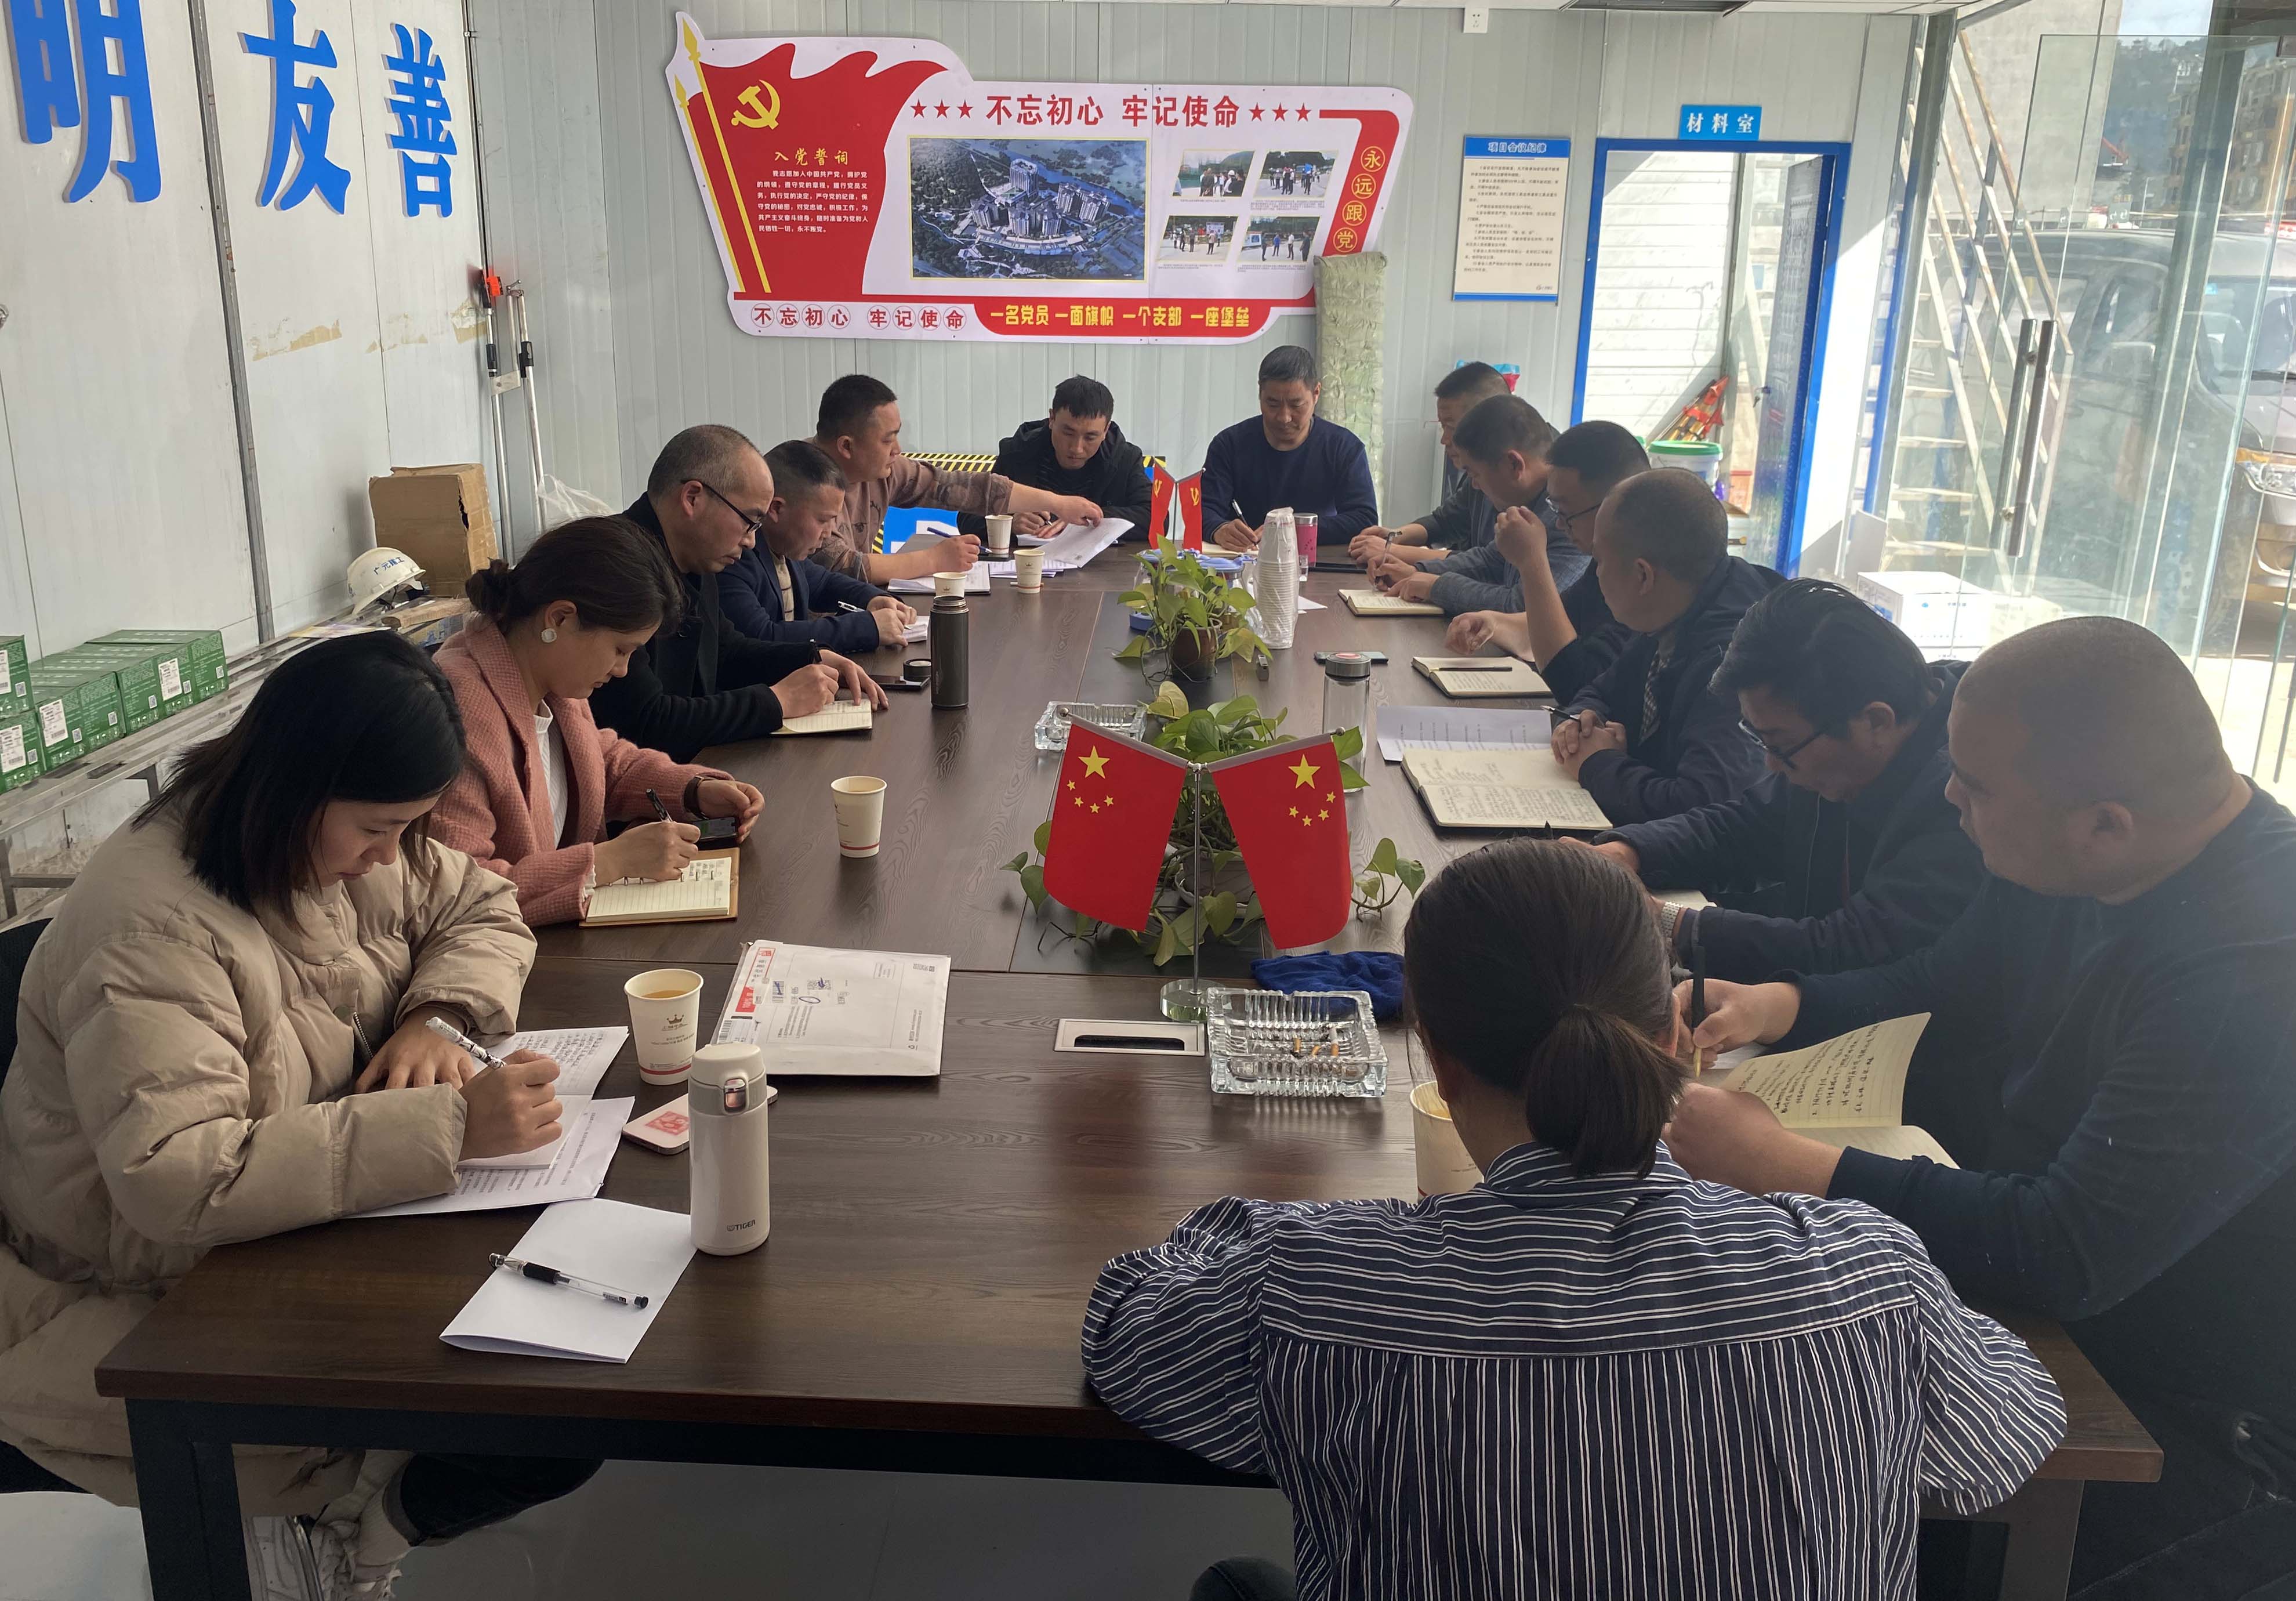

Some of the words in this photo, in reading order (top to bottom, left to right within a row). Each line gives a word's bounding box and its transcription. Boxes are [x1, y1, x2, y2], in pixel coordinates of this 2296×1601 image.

[5, 0, 161, 203] 明
[237, 0, 458, 218] 友善
[986, 94, 1103, 127] 不忘初心
[1122, 94, 1240, 128] 牢记使命
[1686, 112, 1754, 133] 材料室
[774, 147, 848, 166] 入党誓词
[1488, 142, 1547, 154] 项目会议纪律
[1336, 148, 1384, 250] 永远跟党
[754, 308, 849, 327] 不忘初心
[869, 308, 964, 329] 牢记使命
[991, 305, 1049, 326] 一名党员
[1054, 305, 1114, 326] 一面旗帜
[1122, 306, 1182, 326] 一个支部
[1190, 306, 1250, 327] 一座堡垒
